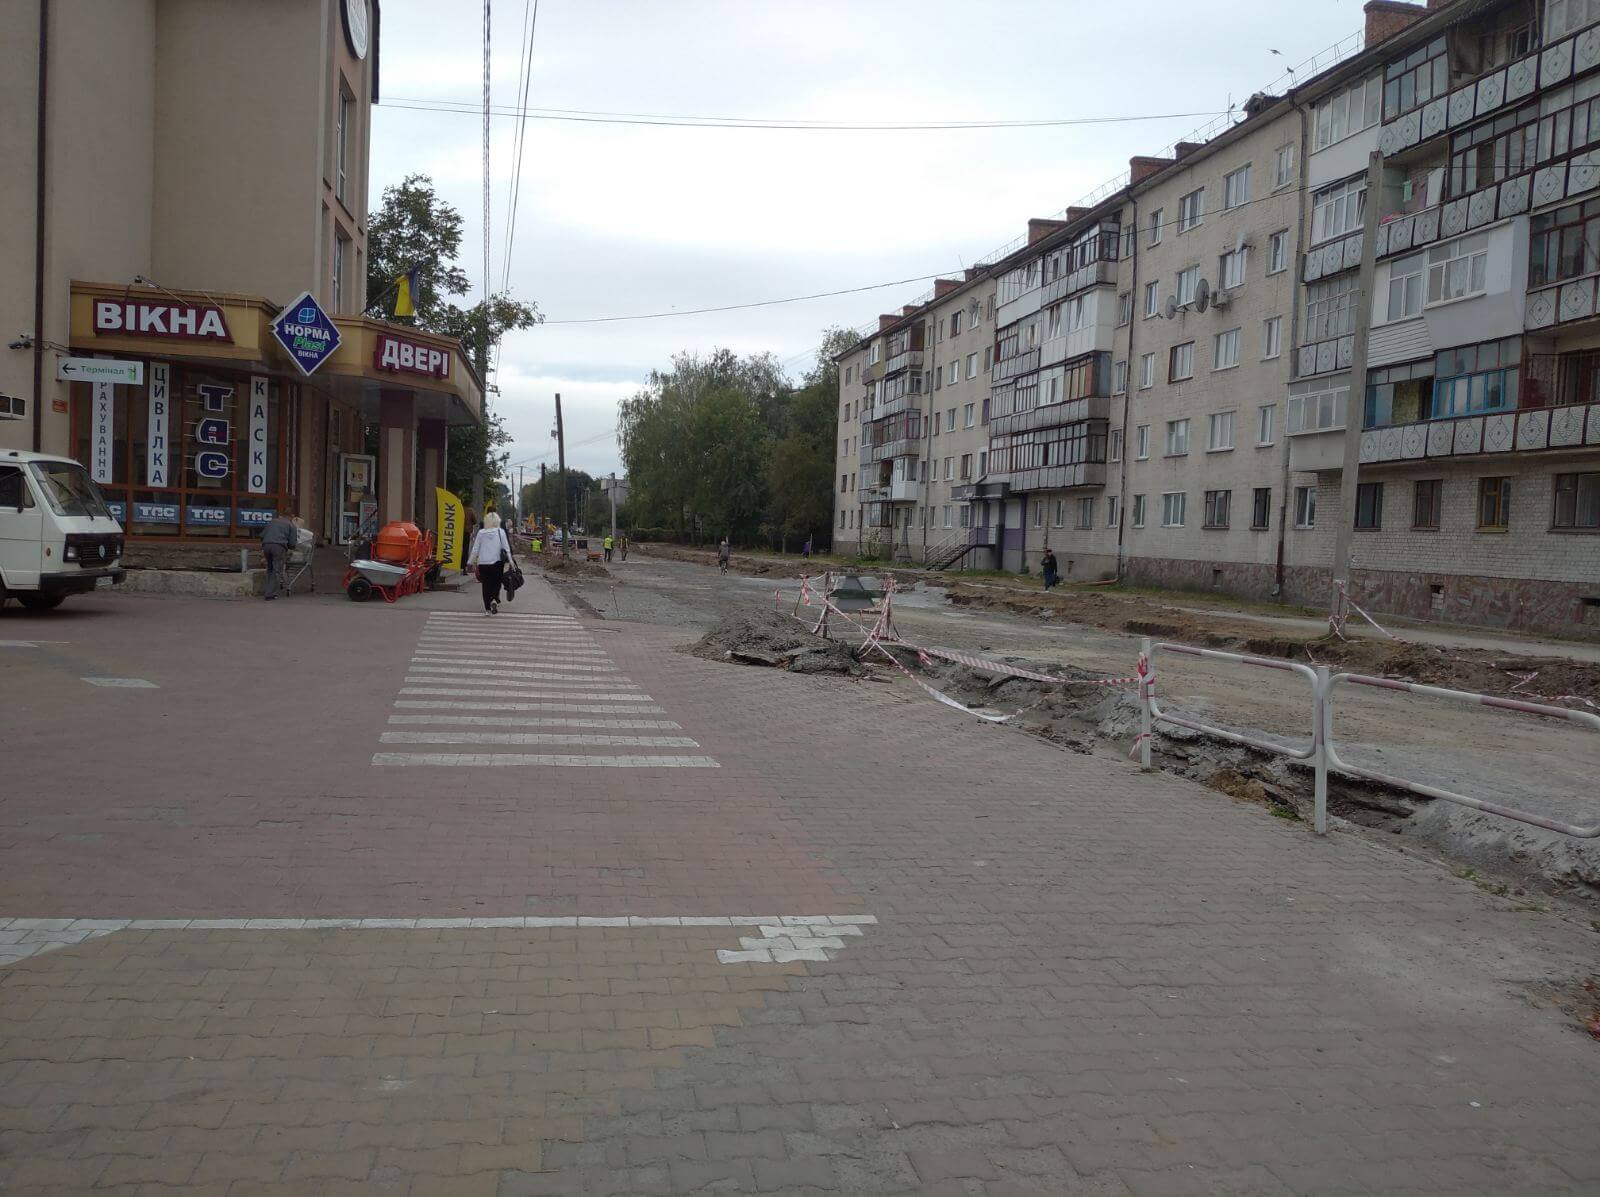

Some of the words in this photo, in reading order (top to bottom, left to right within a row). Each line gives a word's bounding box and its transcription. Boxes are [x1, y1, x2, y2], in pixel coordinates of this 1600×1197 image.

[97, 302, 226, 337] ВІКНА
[284, 324, 331, 341] НОРМА
[293, 336, 326, 353] Plast
[297, 350, 319, 359] ВІКНА
[382, 339, 448, 375] ДВЕРІ
[81, 365, 125, 375] Термінал
[98, 382, 108, 478] РАХУВАННЯ
[152, 366, 167, 484] ЦИВІЛКА
[197, 384, 234, 478] ТАС
[252, 381, 265, 488] КАСКО
